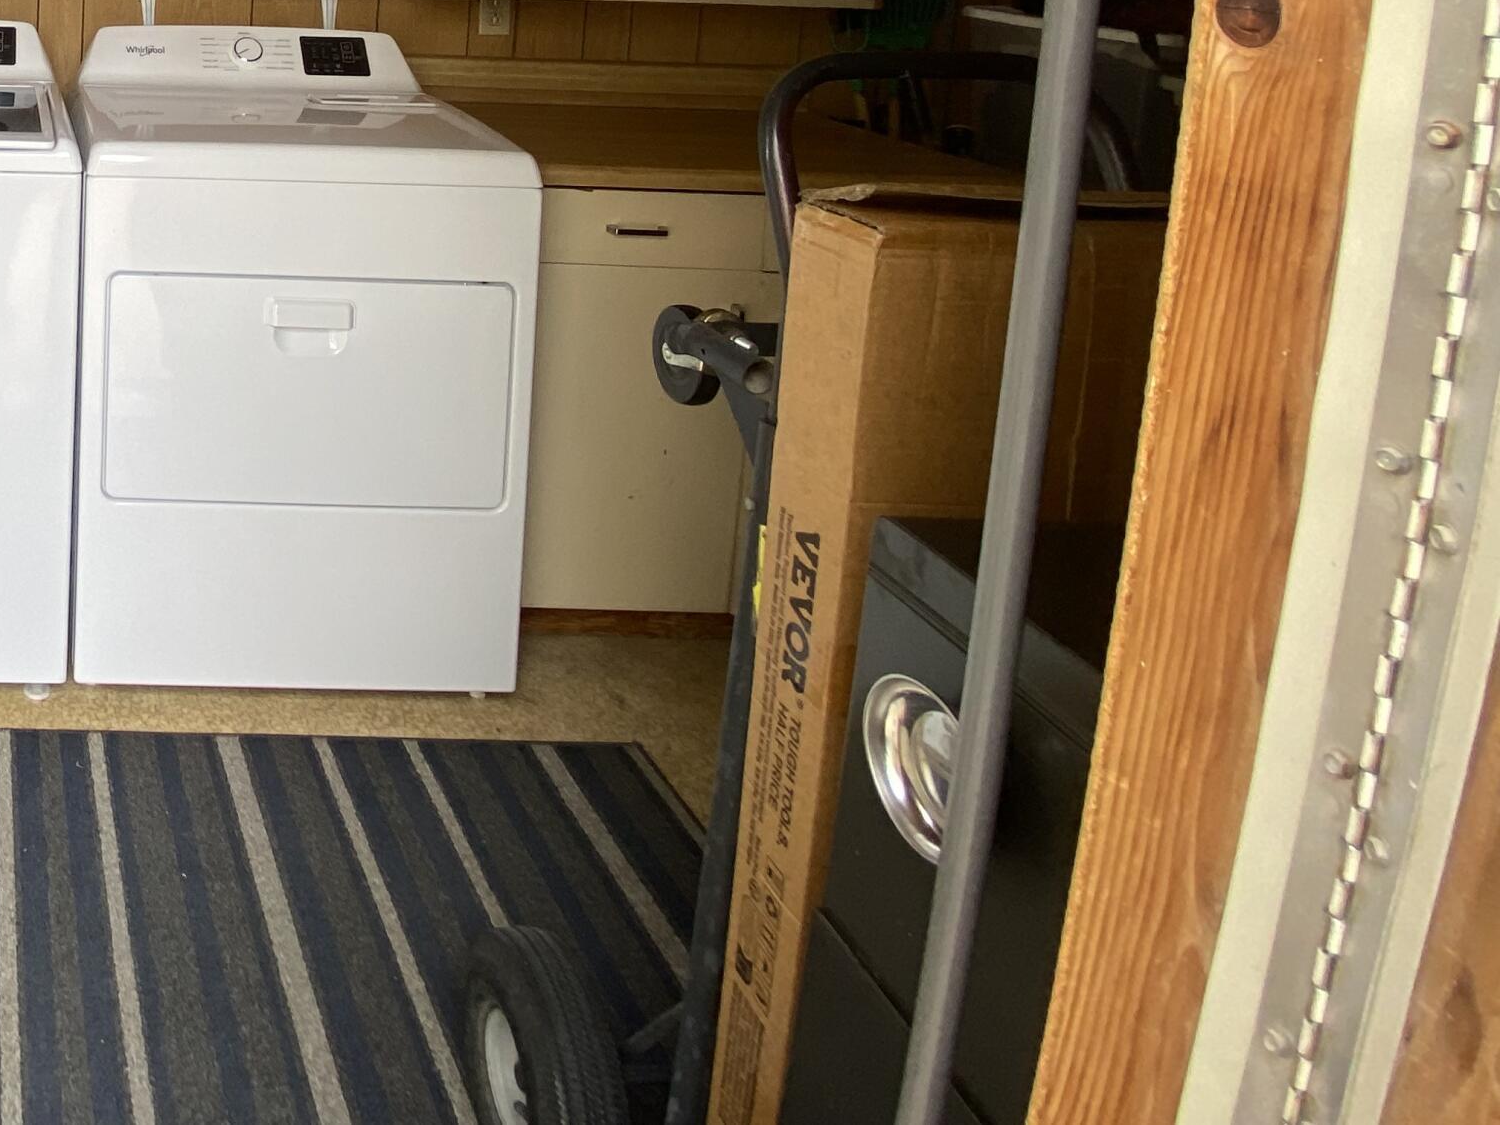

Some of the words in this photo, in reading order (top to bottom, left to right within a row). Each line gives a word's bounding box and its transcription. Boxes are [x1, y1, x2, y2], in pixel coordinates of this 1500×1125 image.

[125, 45, 165, 57] Whirlpool
[781, 531, 821, 694] VEVOR
[773, 702, 790, 754] HALF
[784, 716, 802, 786] TOUGH
[767, 751, 783, 813] PRICE
